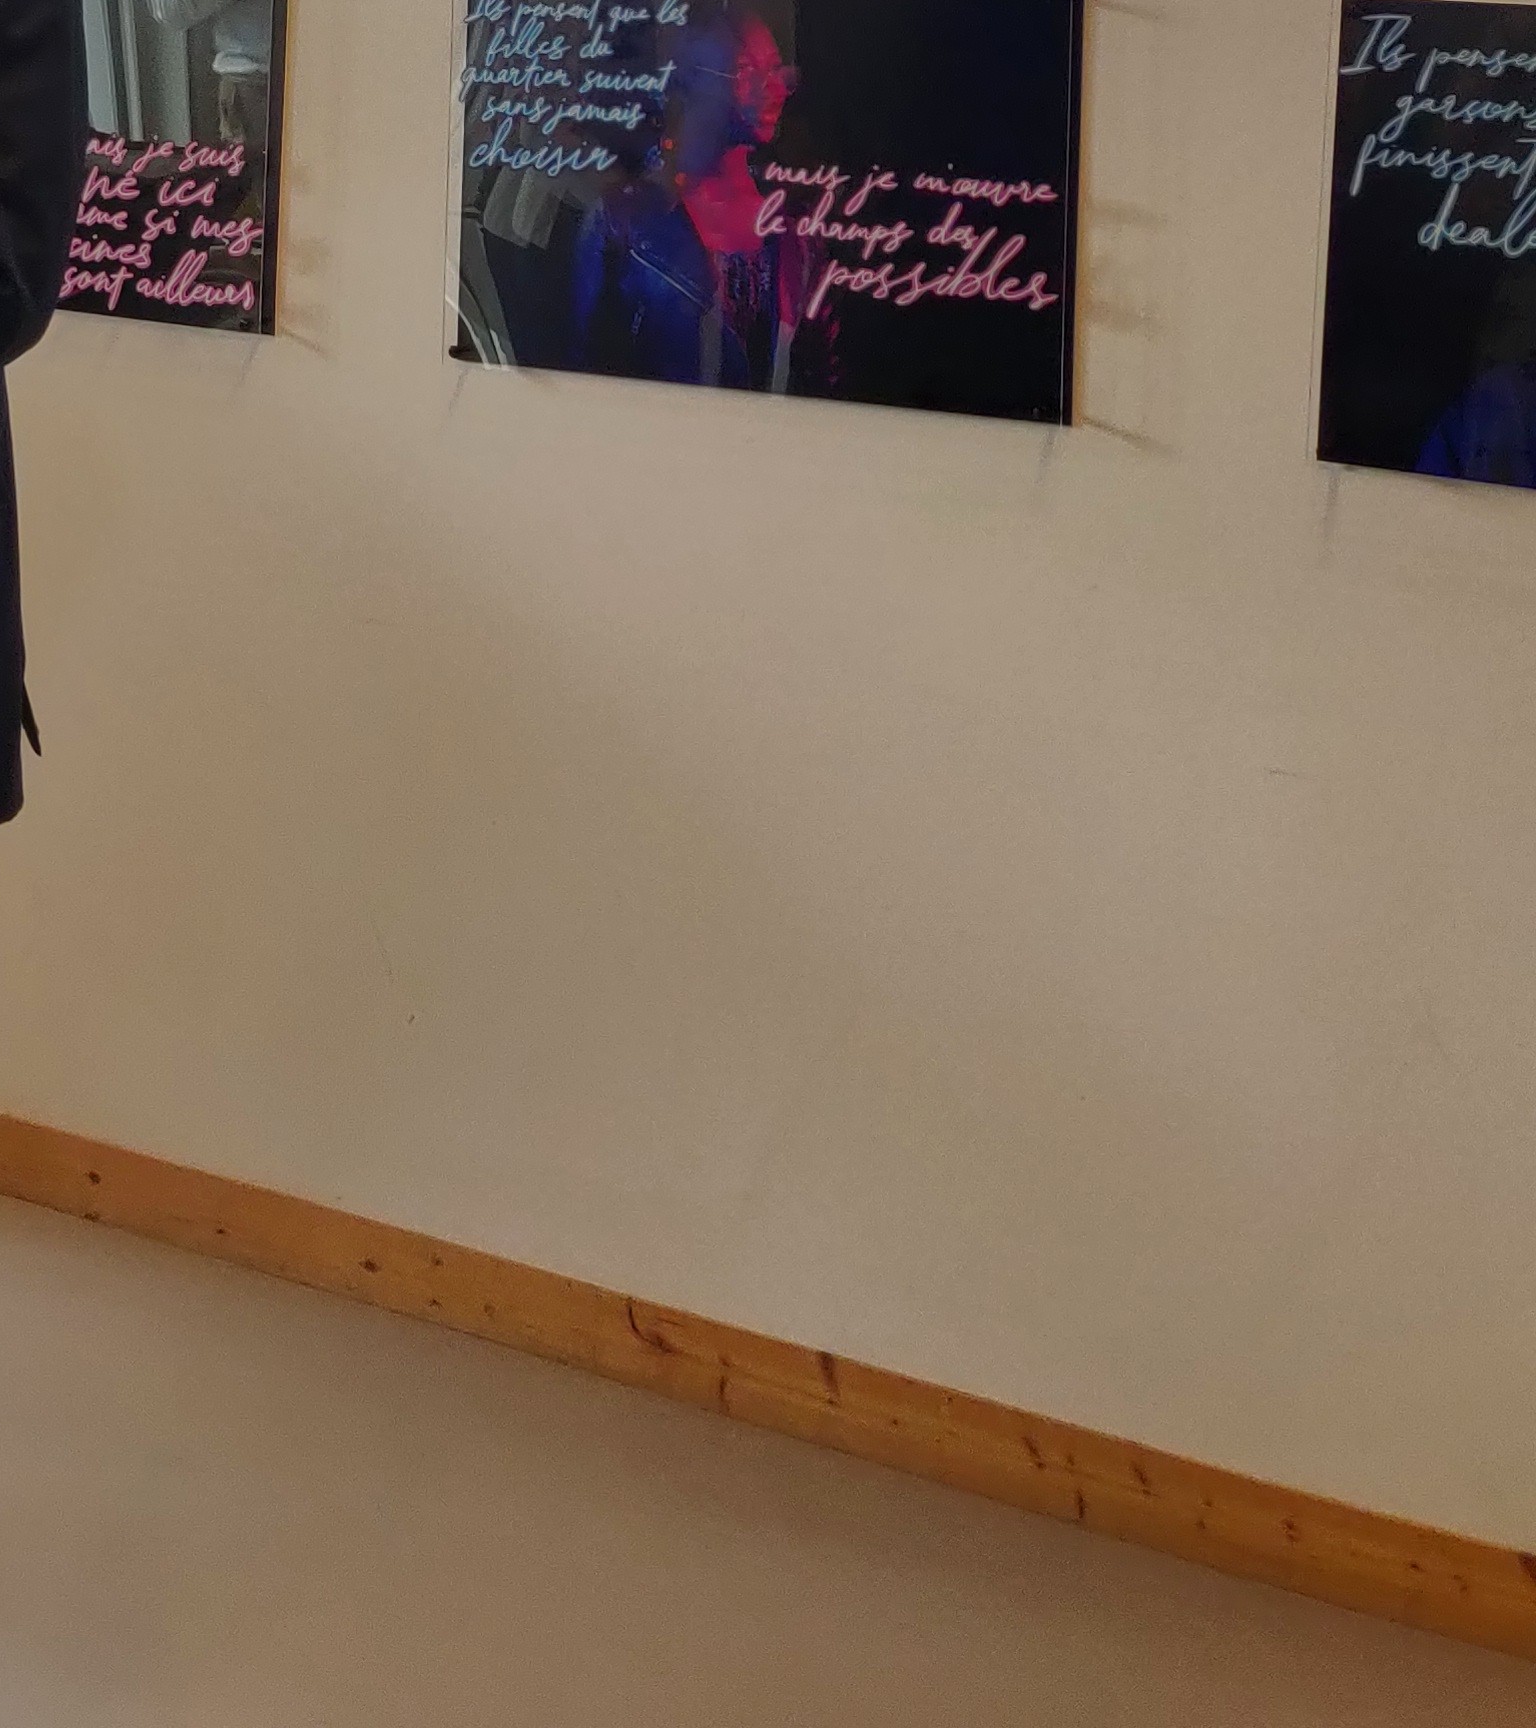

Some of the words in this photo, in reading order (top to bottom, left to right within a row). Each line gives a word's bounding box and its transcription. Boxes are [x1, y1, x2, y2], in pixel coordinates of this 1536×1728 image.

[608, 3, 651, 32] que
[485, 20, 572, 67] filles
[579, 24, 615, 59] du
[1339, 13, 1419, 76] Ils
[458, 57, 572, 103] quartier
[579, 59, 677, 94] suivent
[481, 96, 553, 123] sans
[542, 97, 646, 135] jamais
[132, 134, 174, 172] je
[179, 141, 245, 176] suis
[469, 115, 618, 177] choisir
[158, 176, 220, 207] ici
[765, 161, 851, 193] mais
[844, 164, 899, 217] je
[141, 209, 180, 241] si
[191, 214, 264, 257] mes
[755, 188, 788, 238] le
[796, 190, 916, 261] champs
[926, 201, 979, 252] des
[136, 249, 255, 311] ailleurs
[806, 225, 1061, 321] possibles
